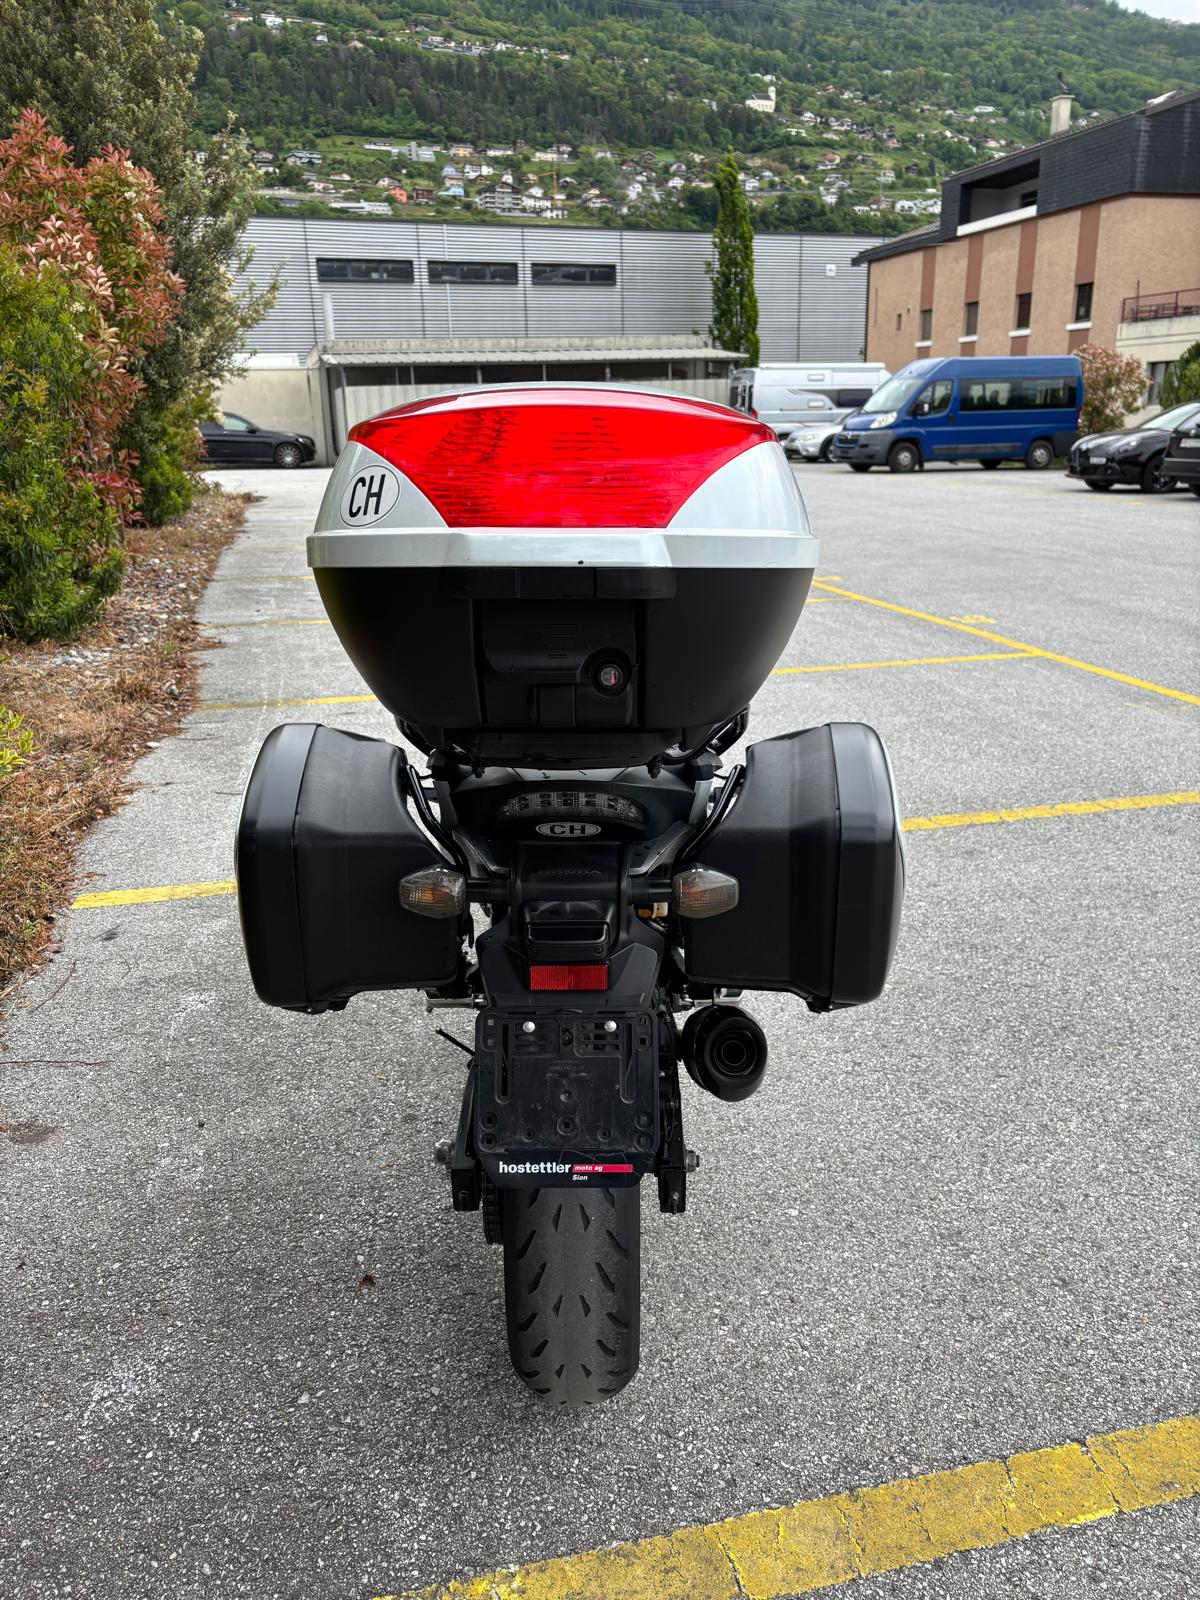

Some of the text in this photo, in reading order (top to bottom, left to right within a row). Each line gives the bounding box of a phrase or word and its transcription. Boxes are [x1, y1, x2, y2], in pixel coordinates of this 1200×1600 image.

[349, 474, 386, 518] CH
[550, 825, 586, 835] CH
[499, 1161, 571, 1174] hostettler
